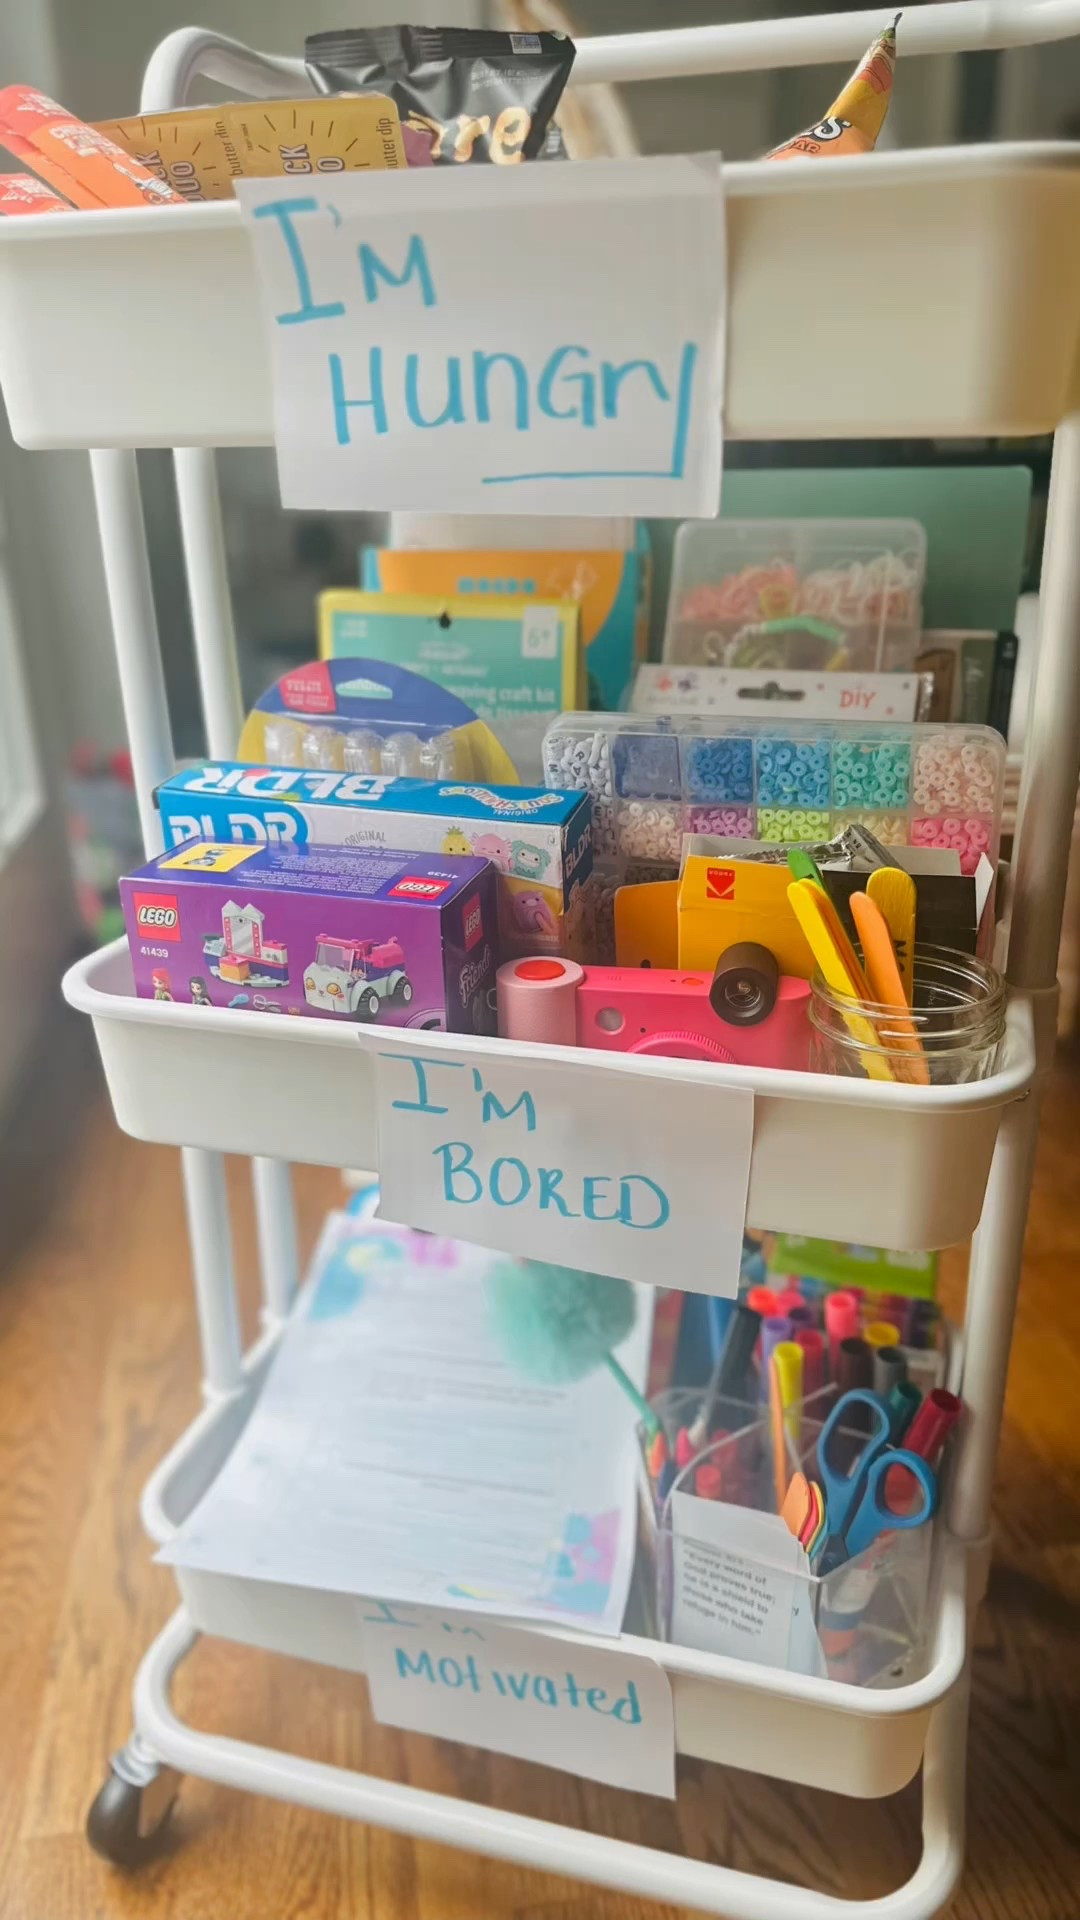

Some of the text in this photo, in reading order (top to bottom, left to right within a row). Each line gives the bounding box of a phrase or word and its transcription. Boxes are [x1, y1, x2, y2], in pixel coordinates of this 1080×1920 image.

[376, 118, 400, 169] utter dip
[184, 767, 398, 801] BLDR
[492, 808, 539, 817] ORIGINAL
[344, 830, 386, 847] ORIGINAL
[426, 871, 460, 880] 41439
[138, 904, 178, 928] LEGO
[465, 907, 482, 937] LEGO
[140, 946, 169, 958] 41439
[432, 1141, 670, 1230] BORED
